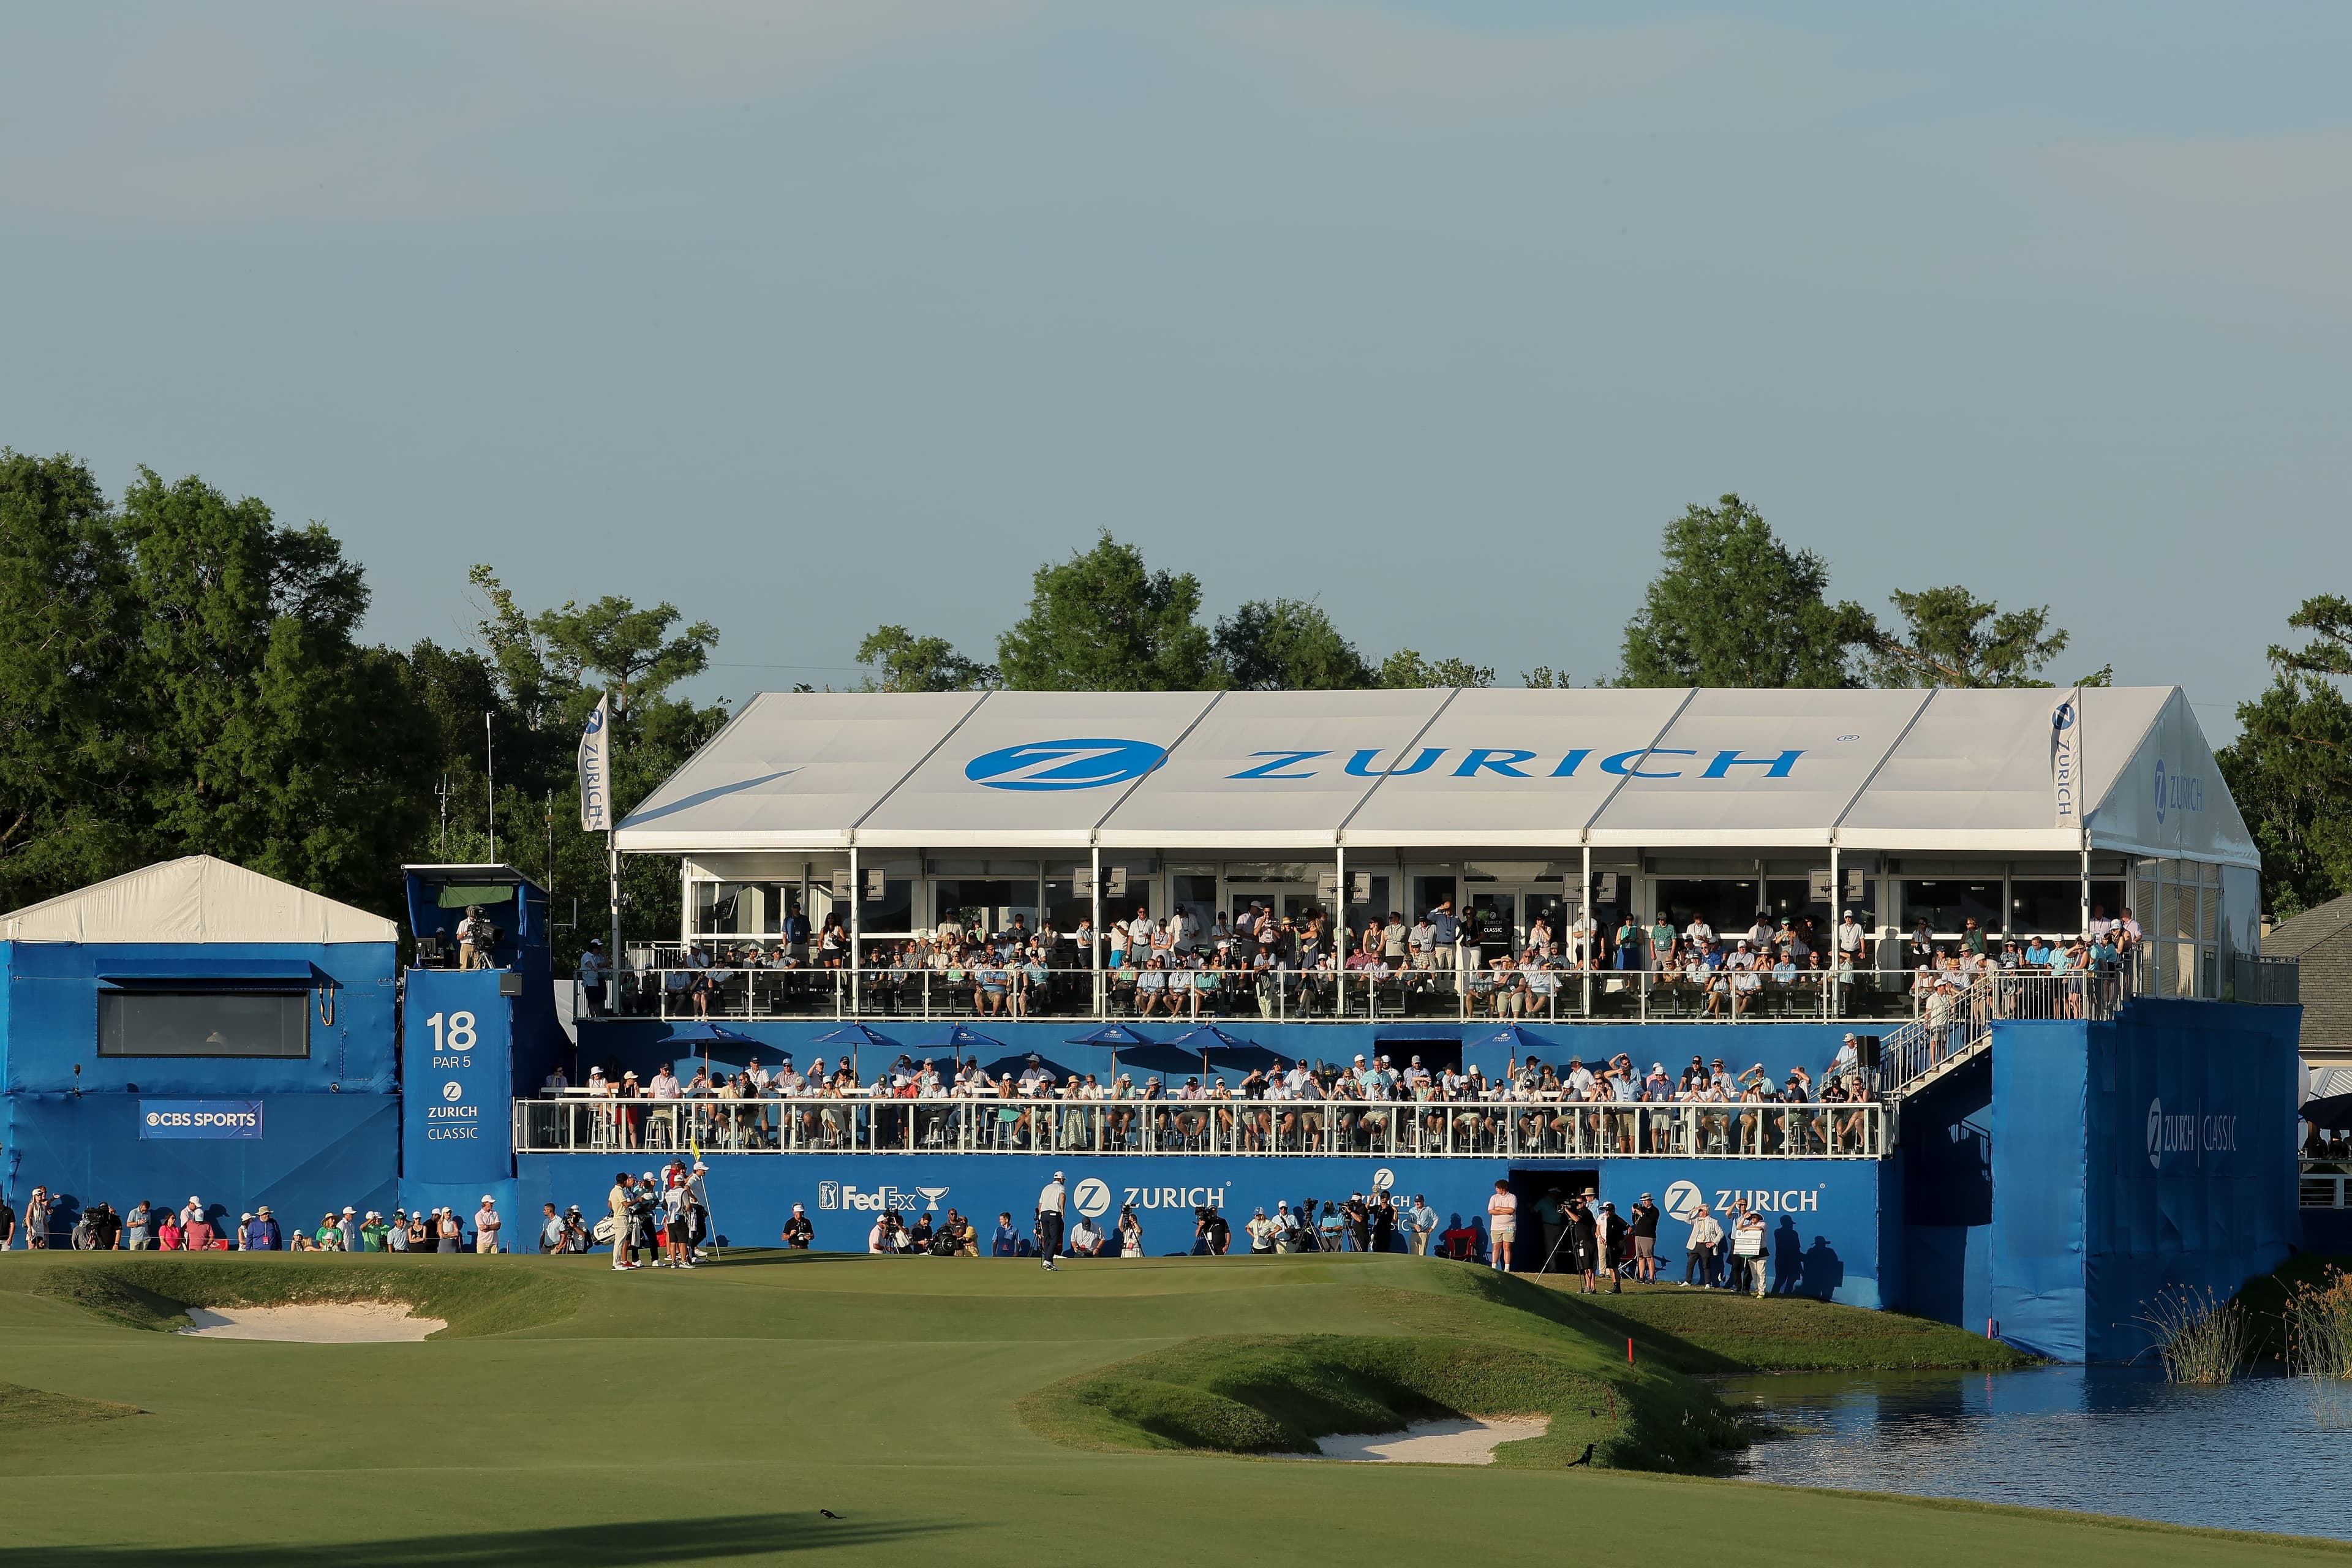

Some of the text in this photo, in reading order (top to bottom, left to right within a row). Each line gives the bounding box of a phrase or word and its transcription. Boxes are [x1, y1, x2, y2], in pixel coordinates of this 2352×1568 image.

[974, 747, 1809, 784] Z ZURICH
[2056, 740, 2071, 815] ZURICH
[584, 744, 602, 818] ZURICH
[2170, 775, 2203, 812] ZURICH
[426, 1011, 477, 1051] 18
[433, 1056, 471, 1069] PAR 5
[445, 1085, 459, 1098] Z
[160, 1112, 256, 1126] CBS SPORTS
[428, 1106, 478, 1118] ZURICH
[428, 1128, 478, 1140] CLASSIC
[2164, 1115, 2195, 1152] ZURCH
[2203, 1115, 2236, 1152] CLASSIC
[842, 1186, 917, 1211] FedEx
[1077, 1185, 1224, 1211] Z ZURICH
[1714, 1190, 1818, 1212] ZURICH
